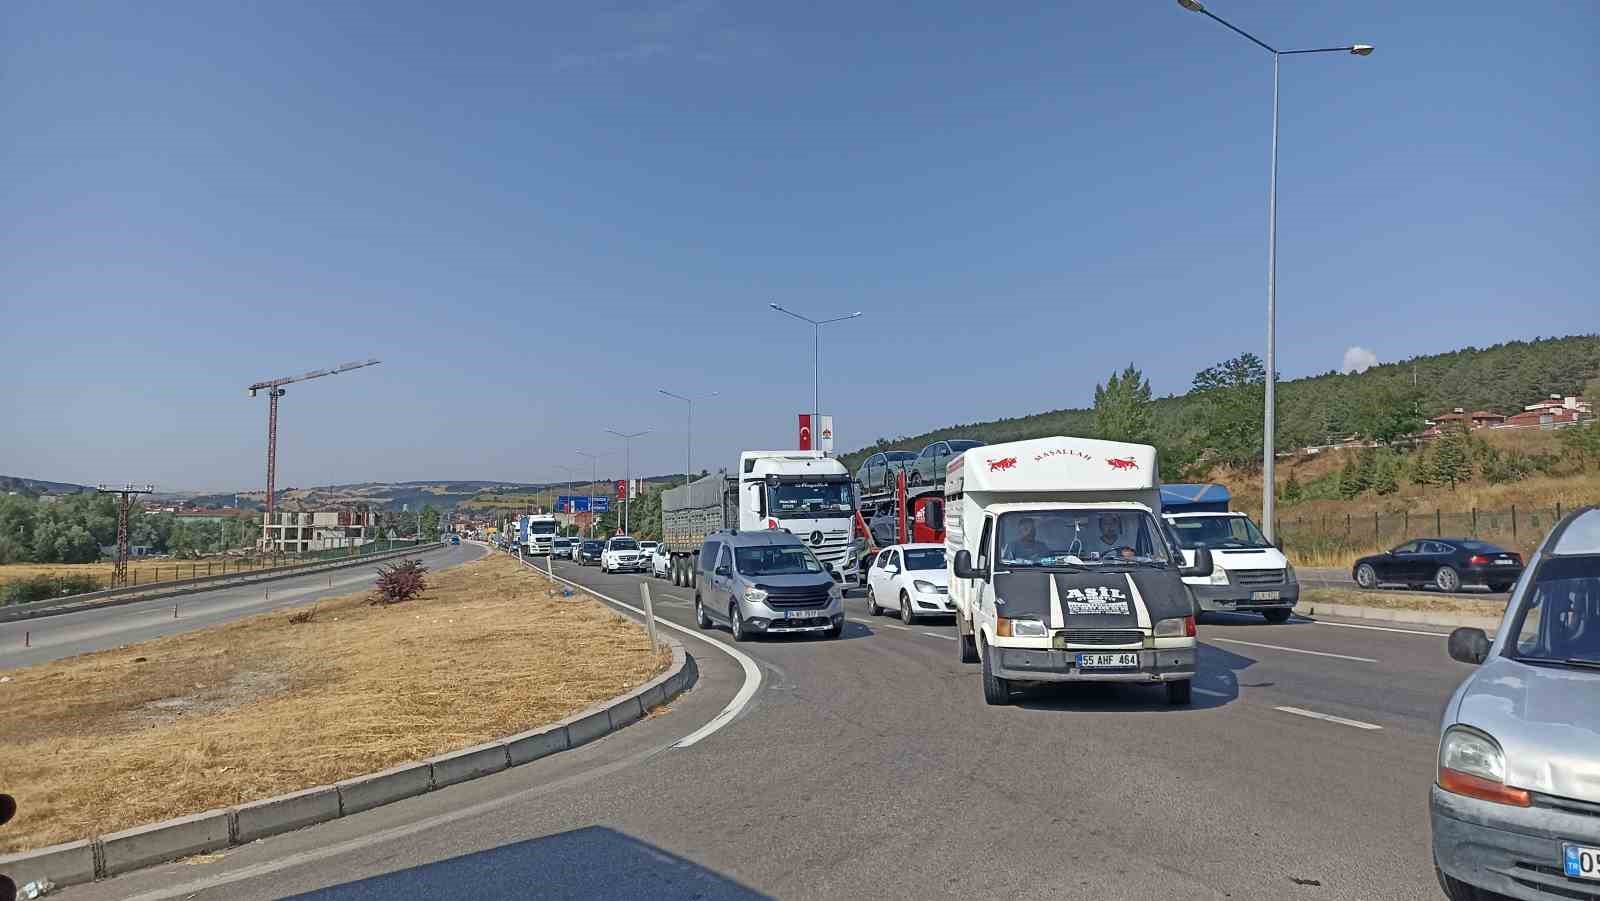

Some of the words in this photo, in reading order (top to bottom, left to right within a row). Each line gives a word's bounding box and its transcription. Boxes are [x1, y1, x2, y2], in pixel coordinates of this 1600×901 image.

[1083, 655, 1094, 665] 55
[1097, 655, 1114, 665] AHF
[1119, 654, 1135, 665] 464
